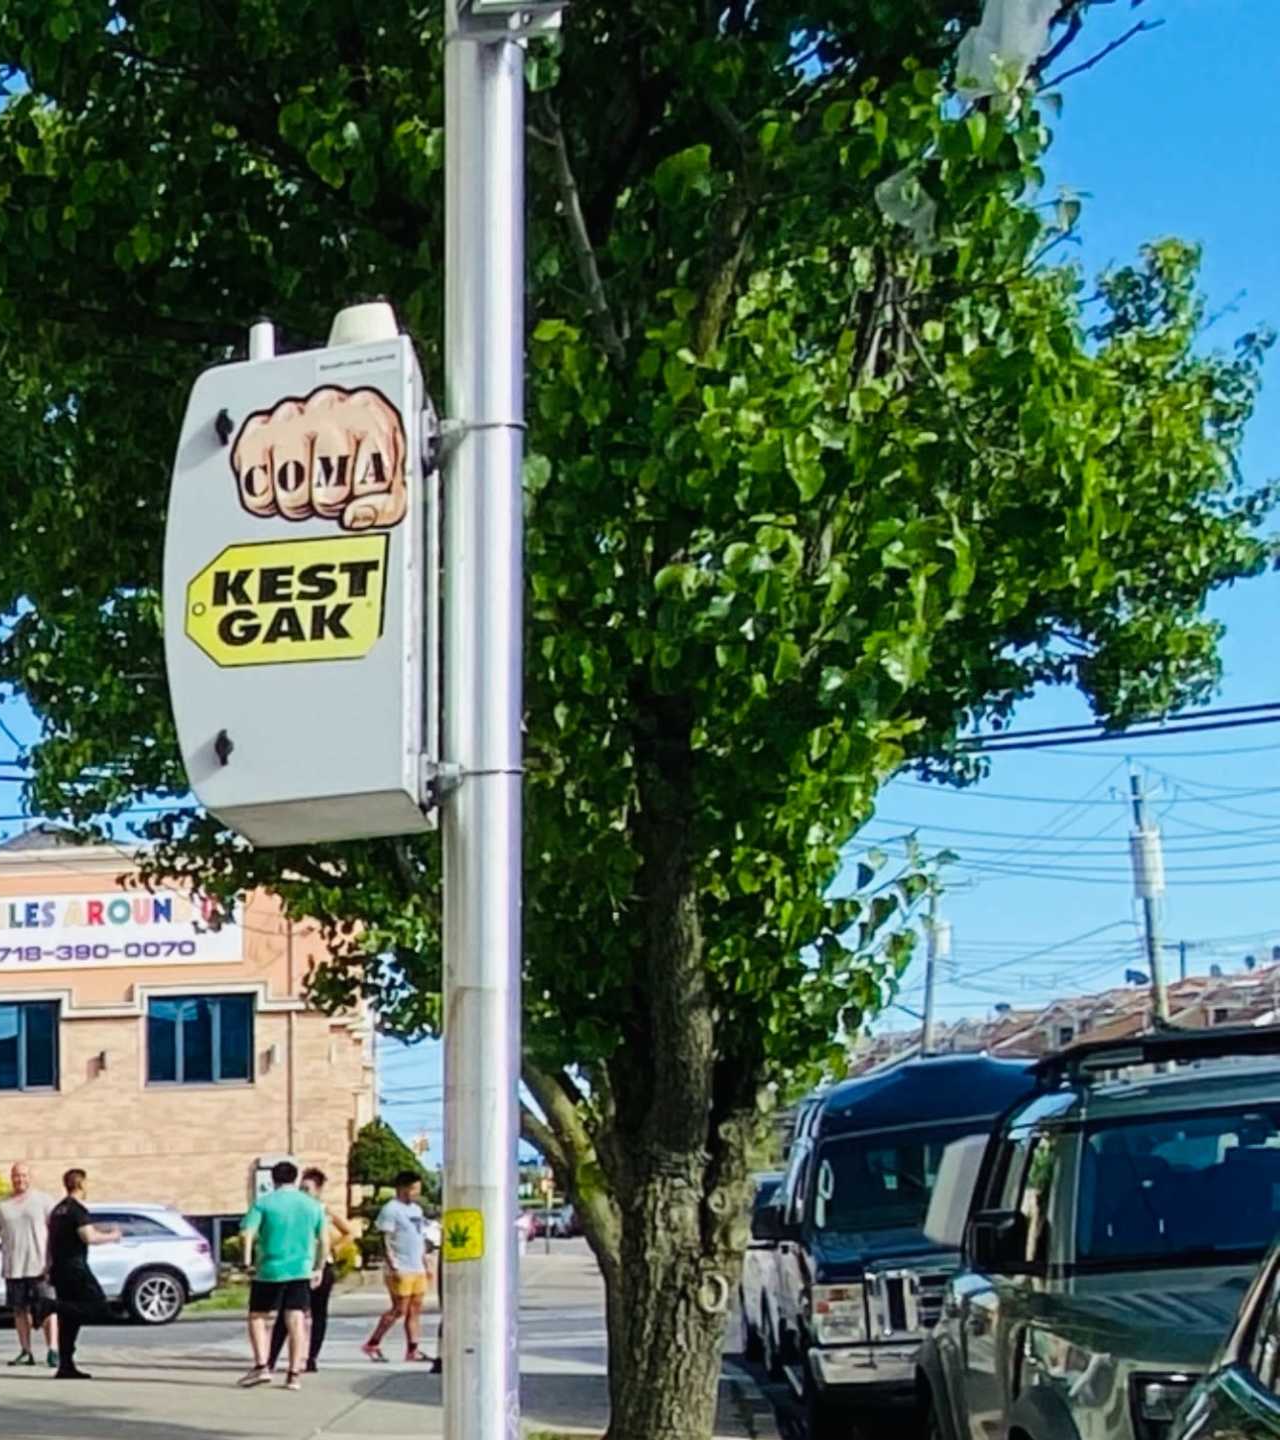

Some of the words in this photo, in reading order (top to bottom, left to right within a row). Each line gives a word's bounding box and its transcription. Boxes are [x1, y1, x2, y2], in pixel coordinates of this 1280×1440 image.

[243, 452, 388, 498] COMA
[211, 559, 380, 607] KEST
[217, 602, 353, 647] GAK
